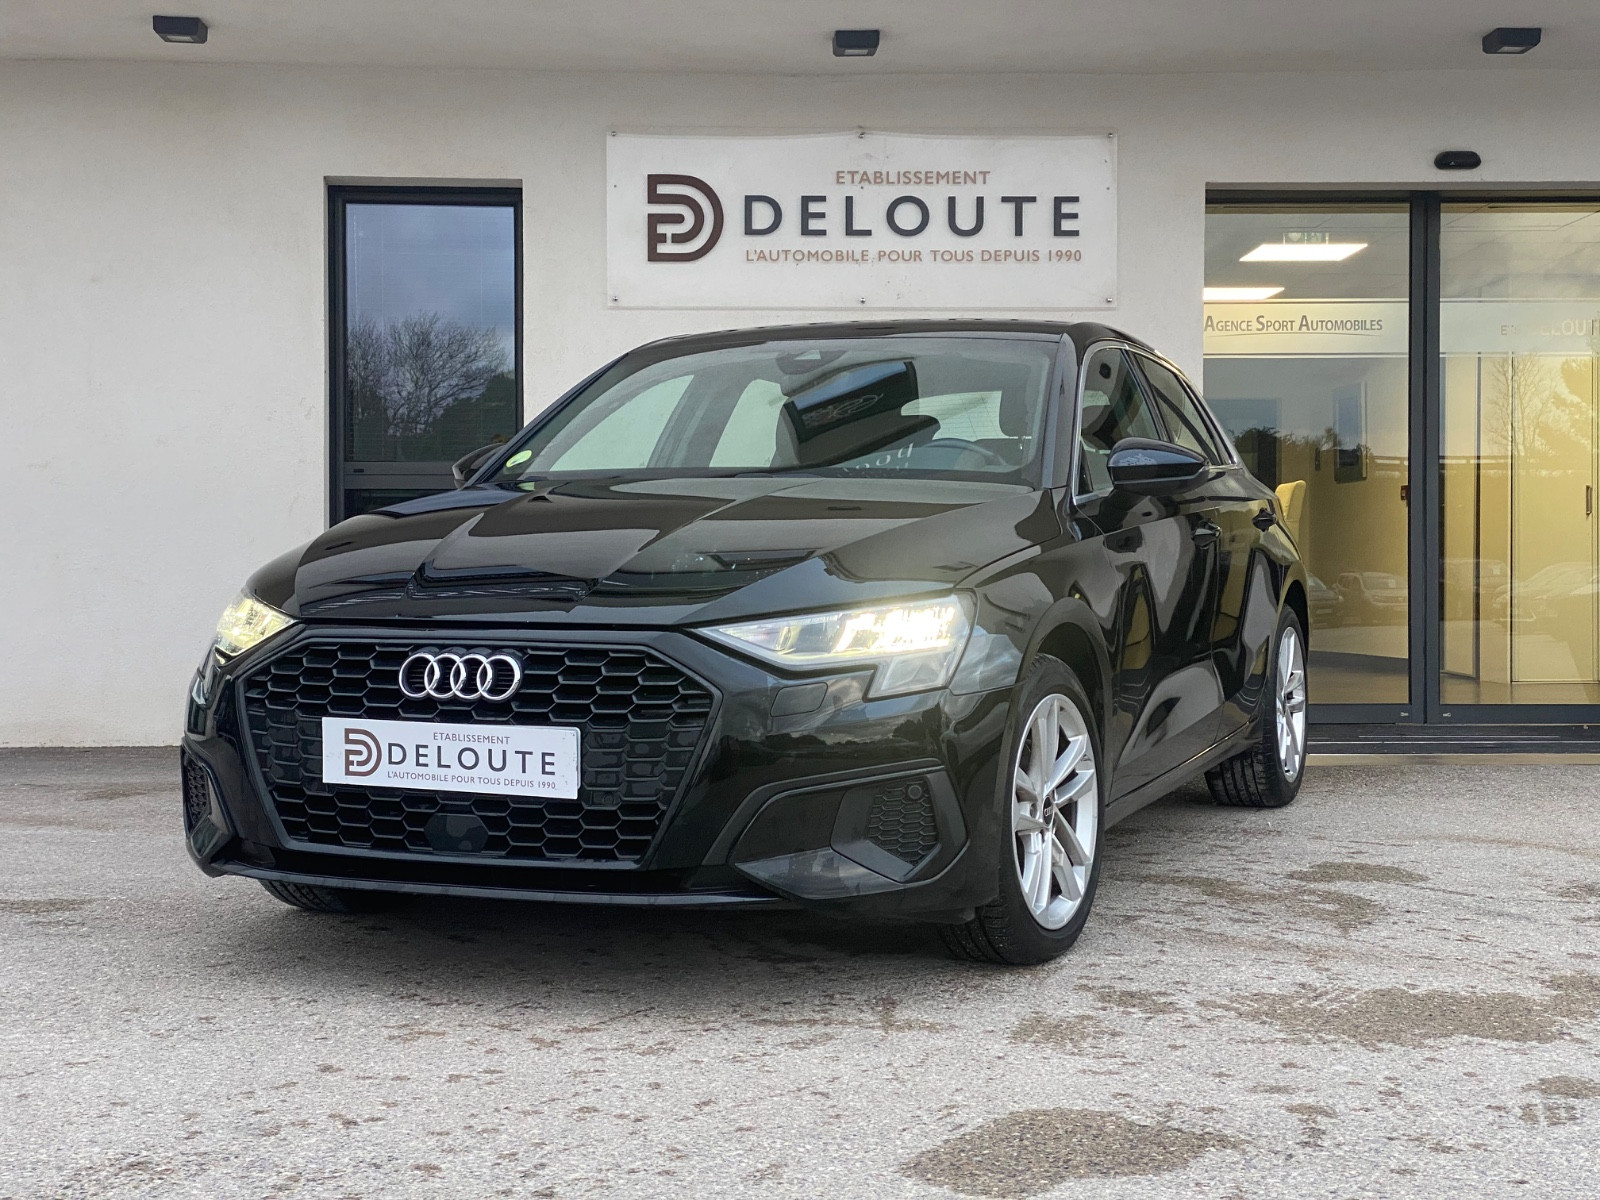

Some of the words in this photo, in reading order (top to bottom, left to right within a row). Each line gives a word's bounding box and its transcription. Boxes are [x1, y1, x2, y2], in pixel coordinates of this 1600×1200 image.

[835, 170, 991, 185] ETABLISSEMENT
[743, 195, 1081, 237] DELOUTE
[745, 249, 870, 263] L'AUTOMOBILE
[877, 249, 923, 262] POUR
[929, 250, 975, 263] TOUS
[980, 250, 1041, 263] DEPUIS
[1047, 250, 1083, 263] 1990
[433, 731, 511, 745] ETABLISSEMENT
[387, 742, 556, 776] DELOUTE
[387, 771, 449, 782] L'AUTOMOBILE
[451, 776, 476, 784] POUR
[478, 777, 502, 786] TOUS
[503, 779, 535, 788] DEPUIS
[537, 781, 556, 789] 1990
